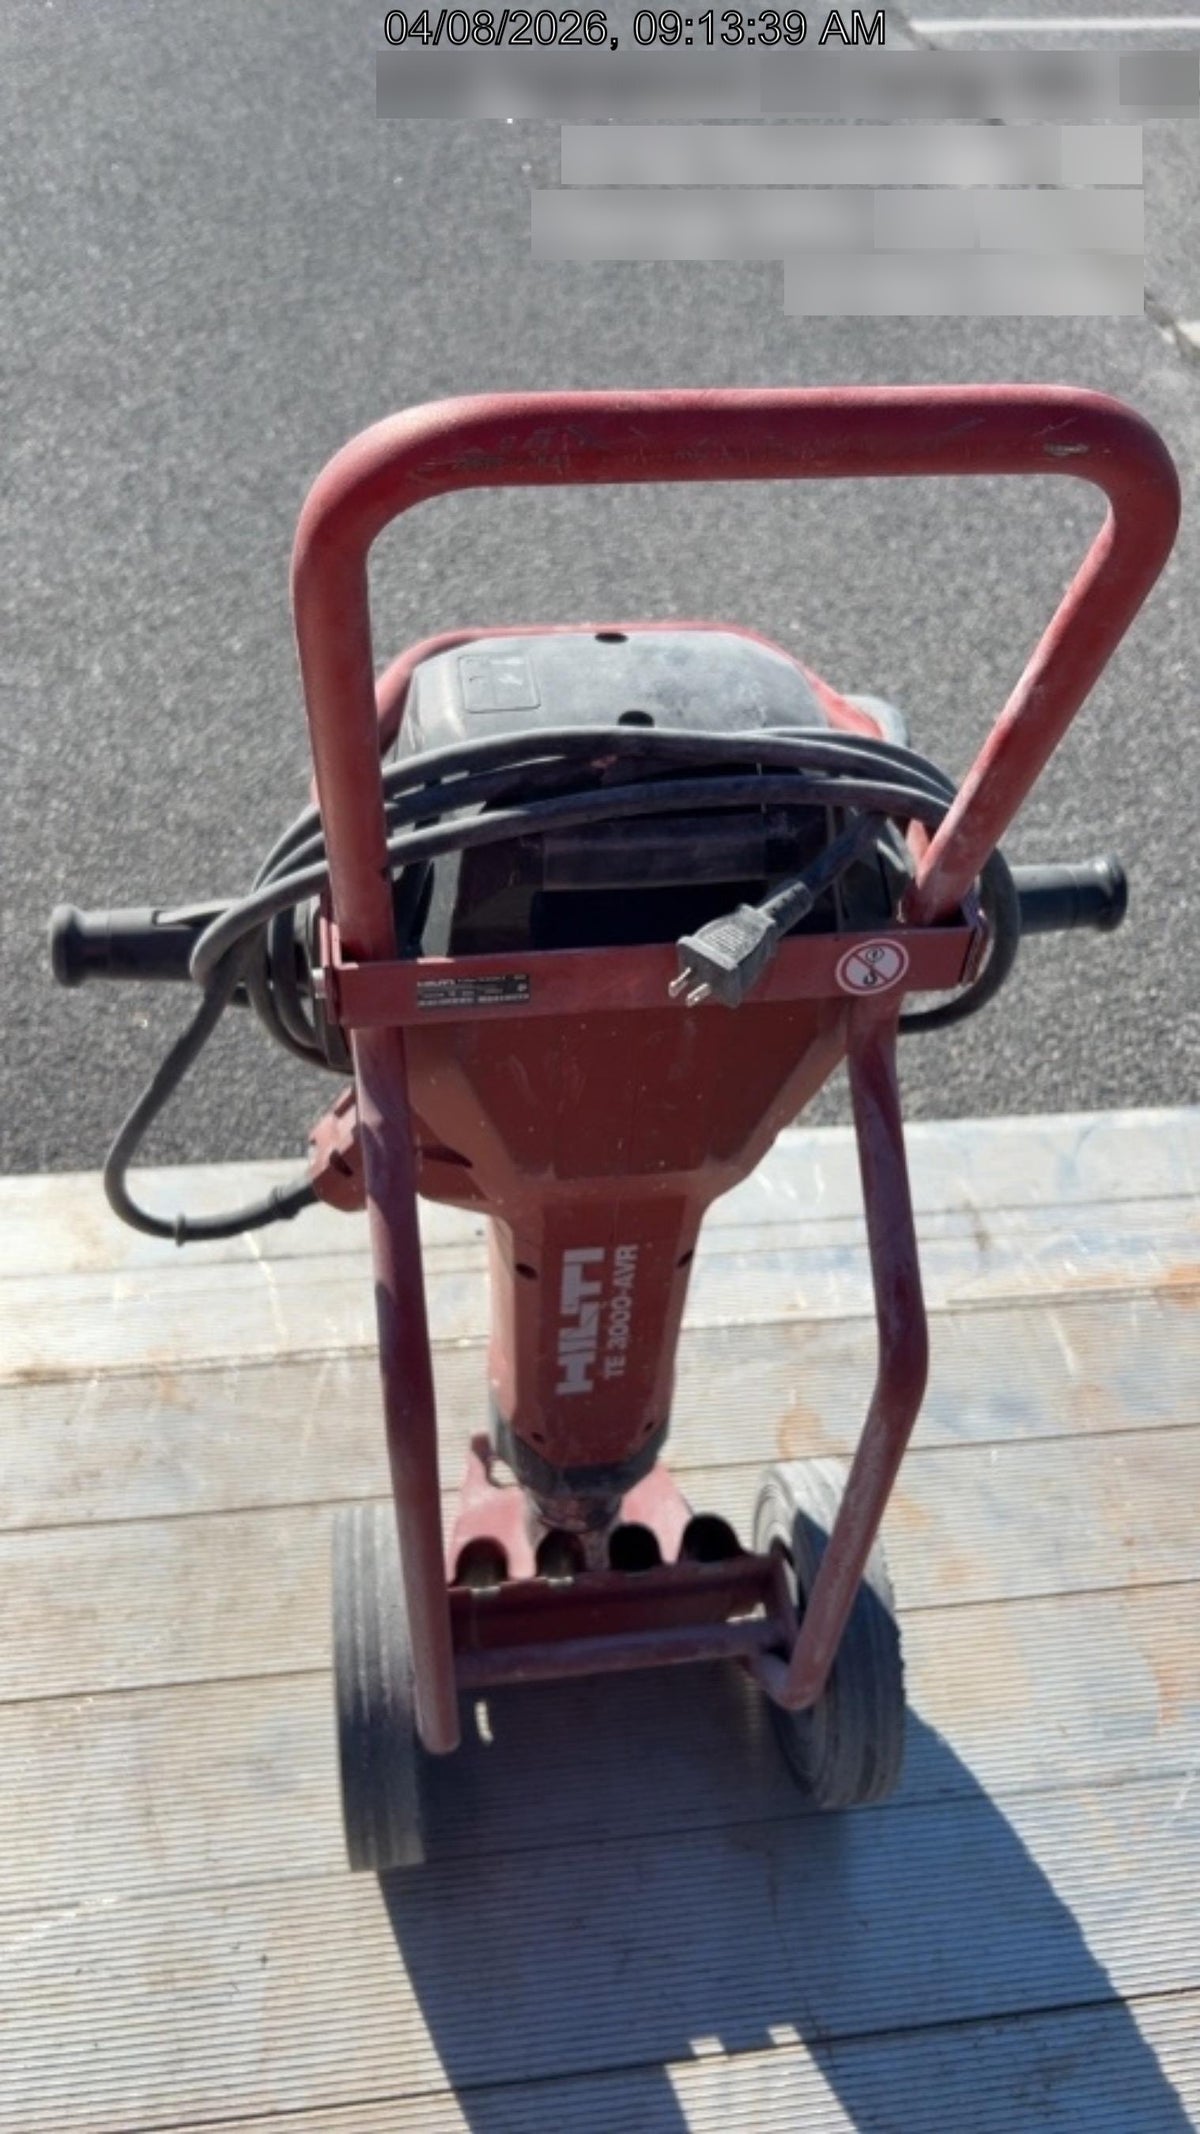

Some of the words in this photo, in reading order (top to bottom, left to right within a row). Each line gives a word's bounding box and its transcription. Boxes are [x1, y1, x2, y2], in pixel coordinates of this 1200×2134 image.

[556, 1247, 605, 1395] HILTI
[607, 1244, 639, 1350] 3000-AVR
[603, 1355, 627, 1381] TE
